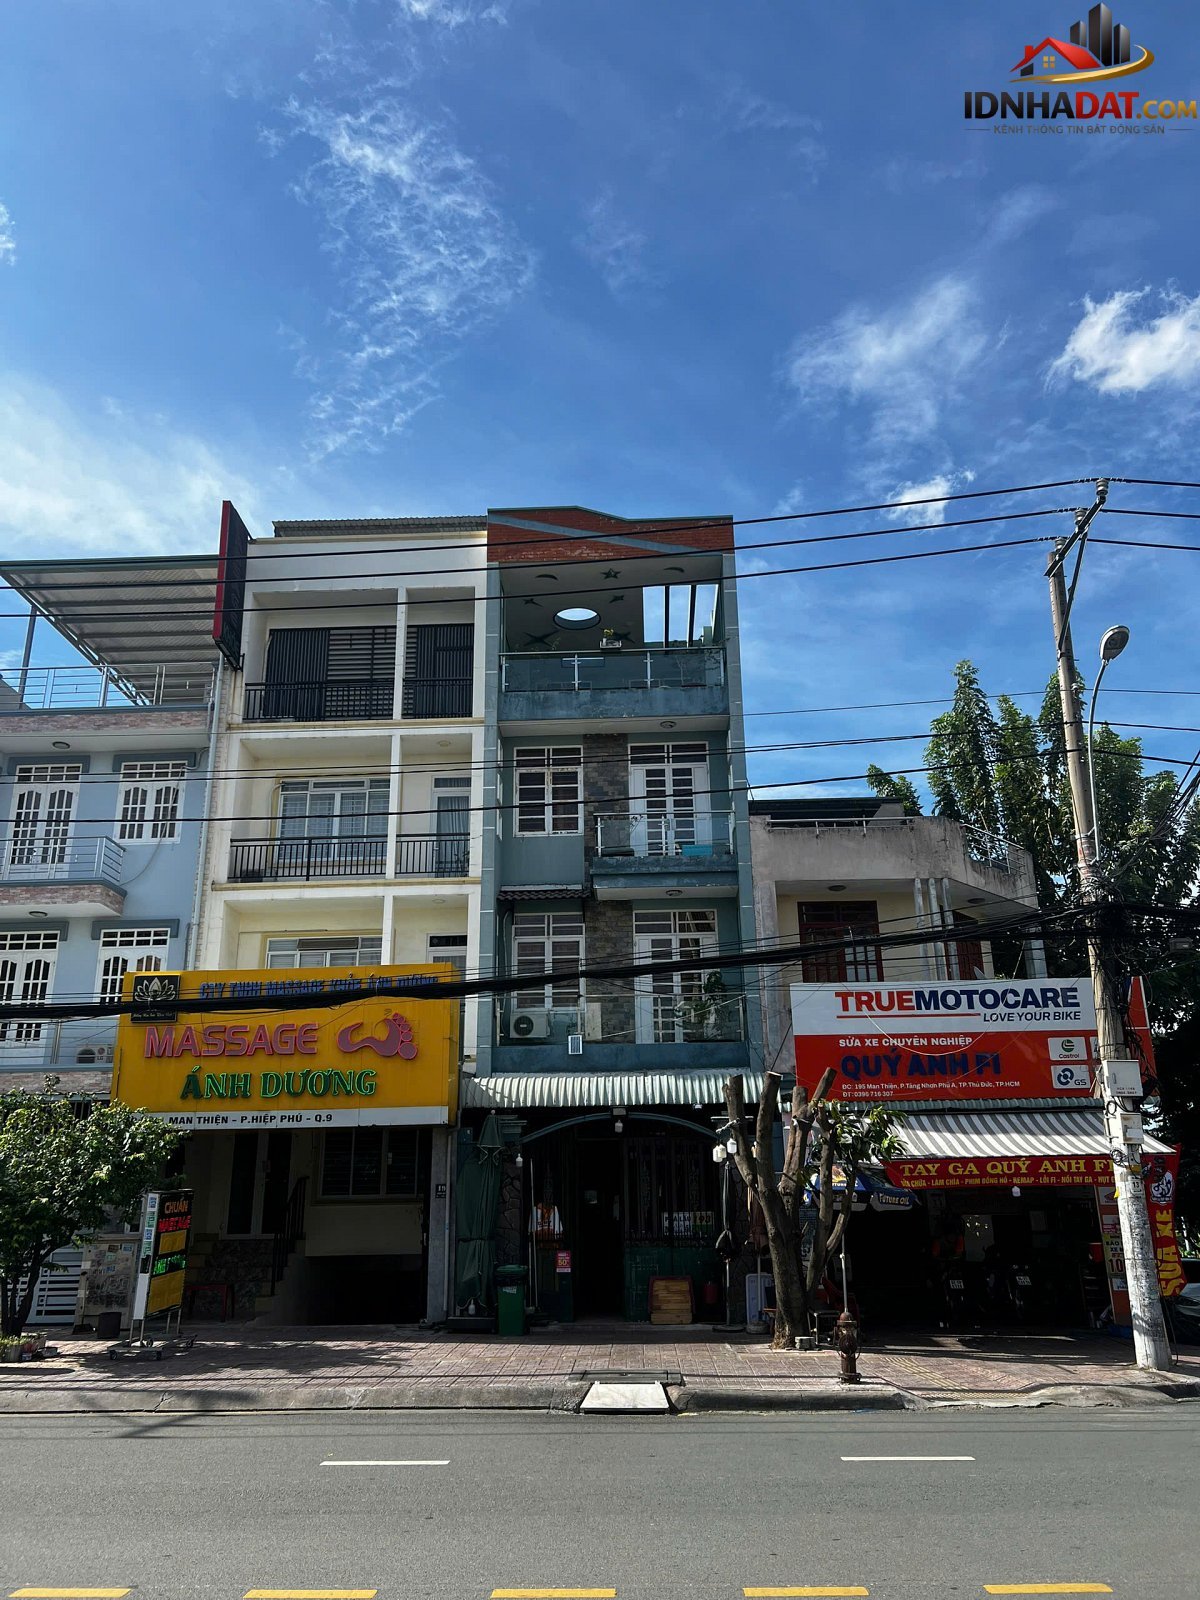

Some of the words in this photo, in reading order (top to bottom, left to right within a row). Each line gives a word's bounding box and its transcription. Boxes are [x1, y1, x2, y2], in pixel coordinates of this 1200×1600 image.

[200, 982, 225, 999] CTY
[229, 982, 262, 998] TNHH
[266, 980, 324, 996] MASSAGE
[835, 987, 1081, 1012] TRUEMOTOCARE
[984, 1012, 1015, 1022] LOVE
[1017, 1011, 1050, 1022] YOUR
[1053, 1010, 1081, 1021] BIKE
[144, 1022, 319, 1058] MASSAGE
[839, 1035, 861, 1047] SỬA
[864, 1038, 879, 1047] XE
[882, 1035, 928, 1047] CHUYÊN
[930, 1034, 973, 1048] NGHIỆP
[841, 1048, 902, 1081] QUÝ
[908, 1054, 969, 1076] ANH
[975, 1053, 1001, 1075] FI
[180, 1065, 252, 1099] ÁNH
[260, 1068, 377, 1098] DƯƠNG
[169, 1116, 193, 1125] MAN
[197, 1114, 228, 1126] THIỆN
[240, 1113, 276, 1126] P.HIỆP
[280, 1112, 302, 1123] PHÚ
[314, 1113, 333, 1123] Q.9
[900, 1163, 941, 1176] TAY
[947, 1162, 980, 1175] GA
[986, 1158, 1031, 1175] QUÝ
[1039, 1159, 1086, 1173] ANH
[1132, 1181, 1140, 1189] 13
[879, 1193, 899, 1204] FUTURE
[1155, 1209, 1174, 1238] XE
